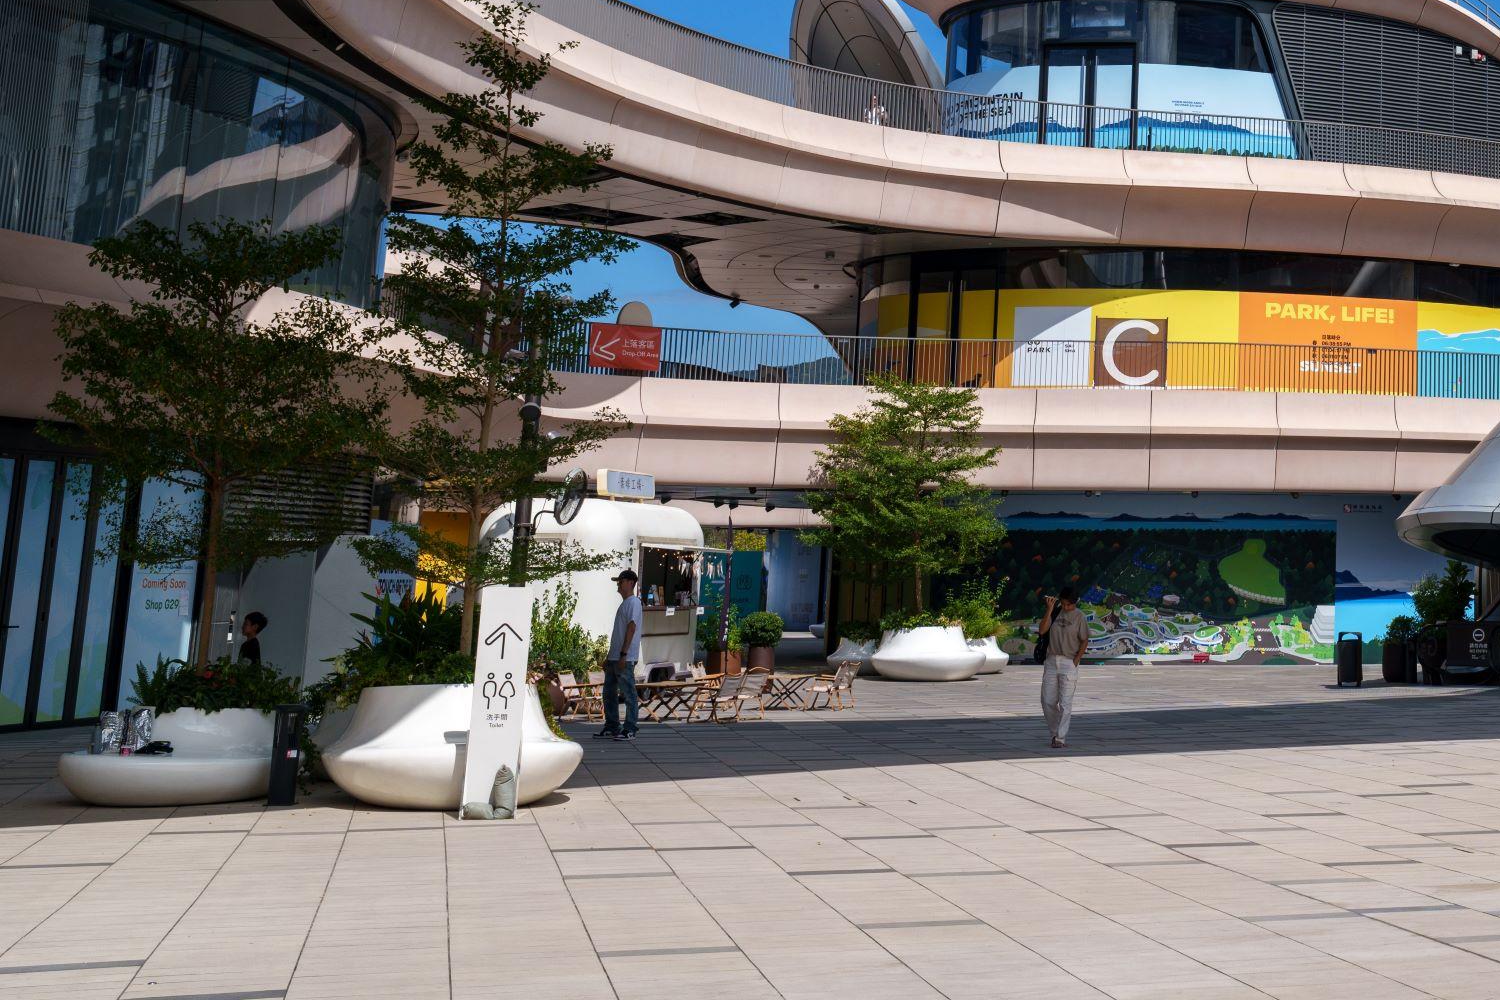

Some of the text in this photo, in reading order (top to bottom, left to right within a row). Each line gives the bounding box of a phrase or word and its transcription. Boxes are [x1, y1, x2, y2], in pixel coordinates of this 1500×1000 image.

[1265, 302, 1395, 325] PARK, LIFE!
[1102, 319, 1160, 386] C
[142, 578, 188, 592] Coming Soon
[145, 599, 180, 612] Shop G29
